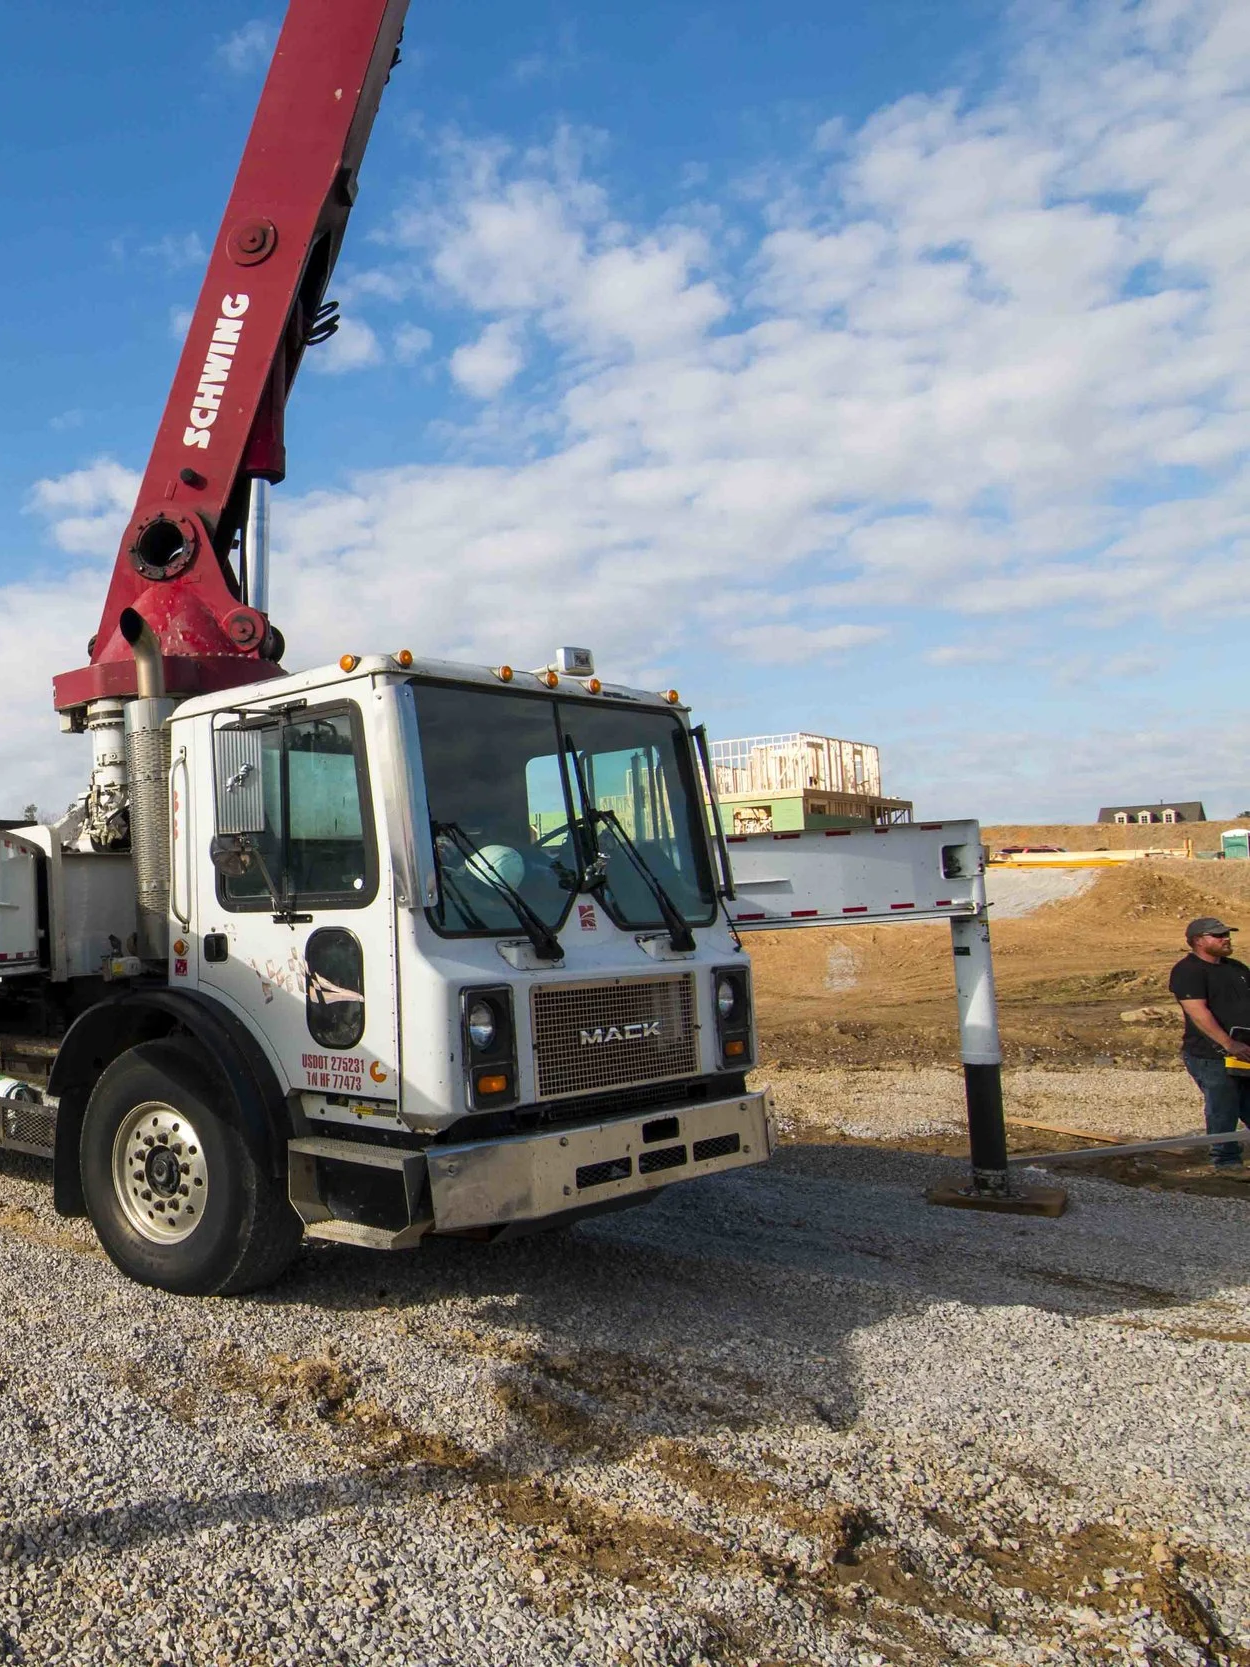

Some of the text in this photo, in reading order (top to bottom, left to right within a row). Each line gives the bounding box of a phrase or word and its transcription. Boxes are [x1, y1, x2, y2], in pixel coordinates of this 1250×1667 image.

[183, 293, 250, 449] SCHWING
[580, 1021, 662, 1045] MACK
[302, 1053, 365, 1074] USDOT 275231
[306, 1071, 362, 1091] TN HF 77473
